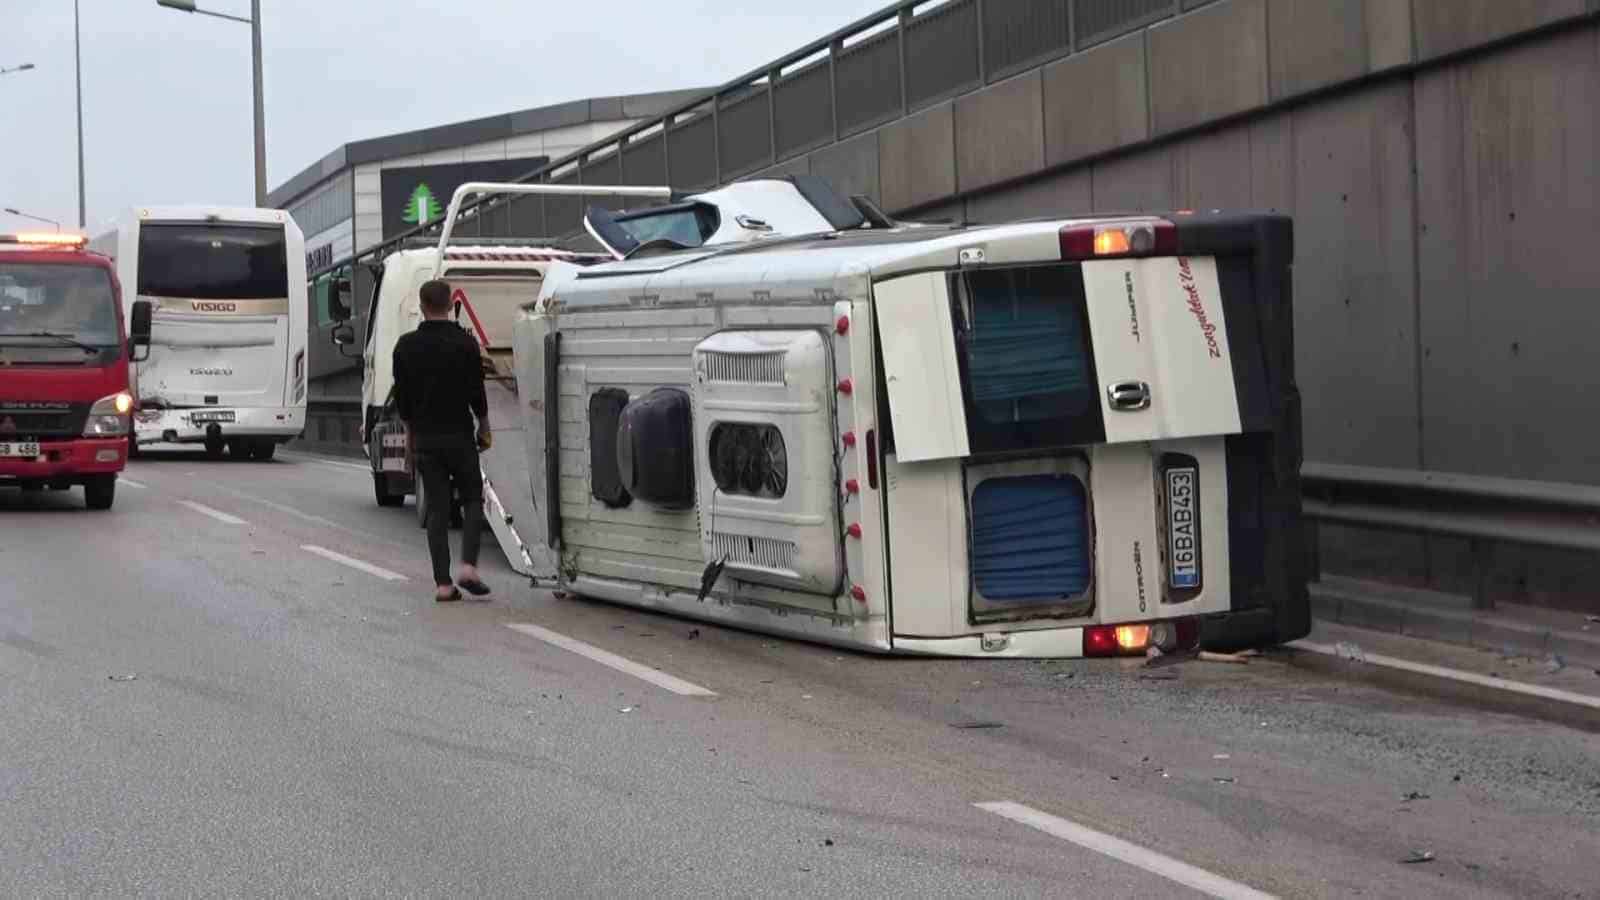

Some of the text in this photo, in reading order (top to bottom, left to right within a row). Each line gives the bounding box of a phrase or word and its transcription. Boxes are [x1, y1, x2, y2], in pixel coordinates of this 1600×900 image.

[191, 302, 236, 312] VISIGO
[1124, 271, 1141, 344] JUMPER
[1172, 474, 1194, 572] 16BAB453
